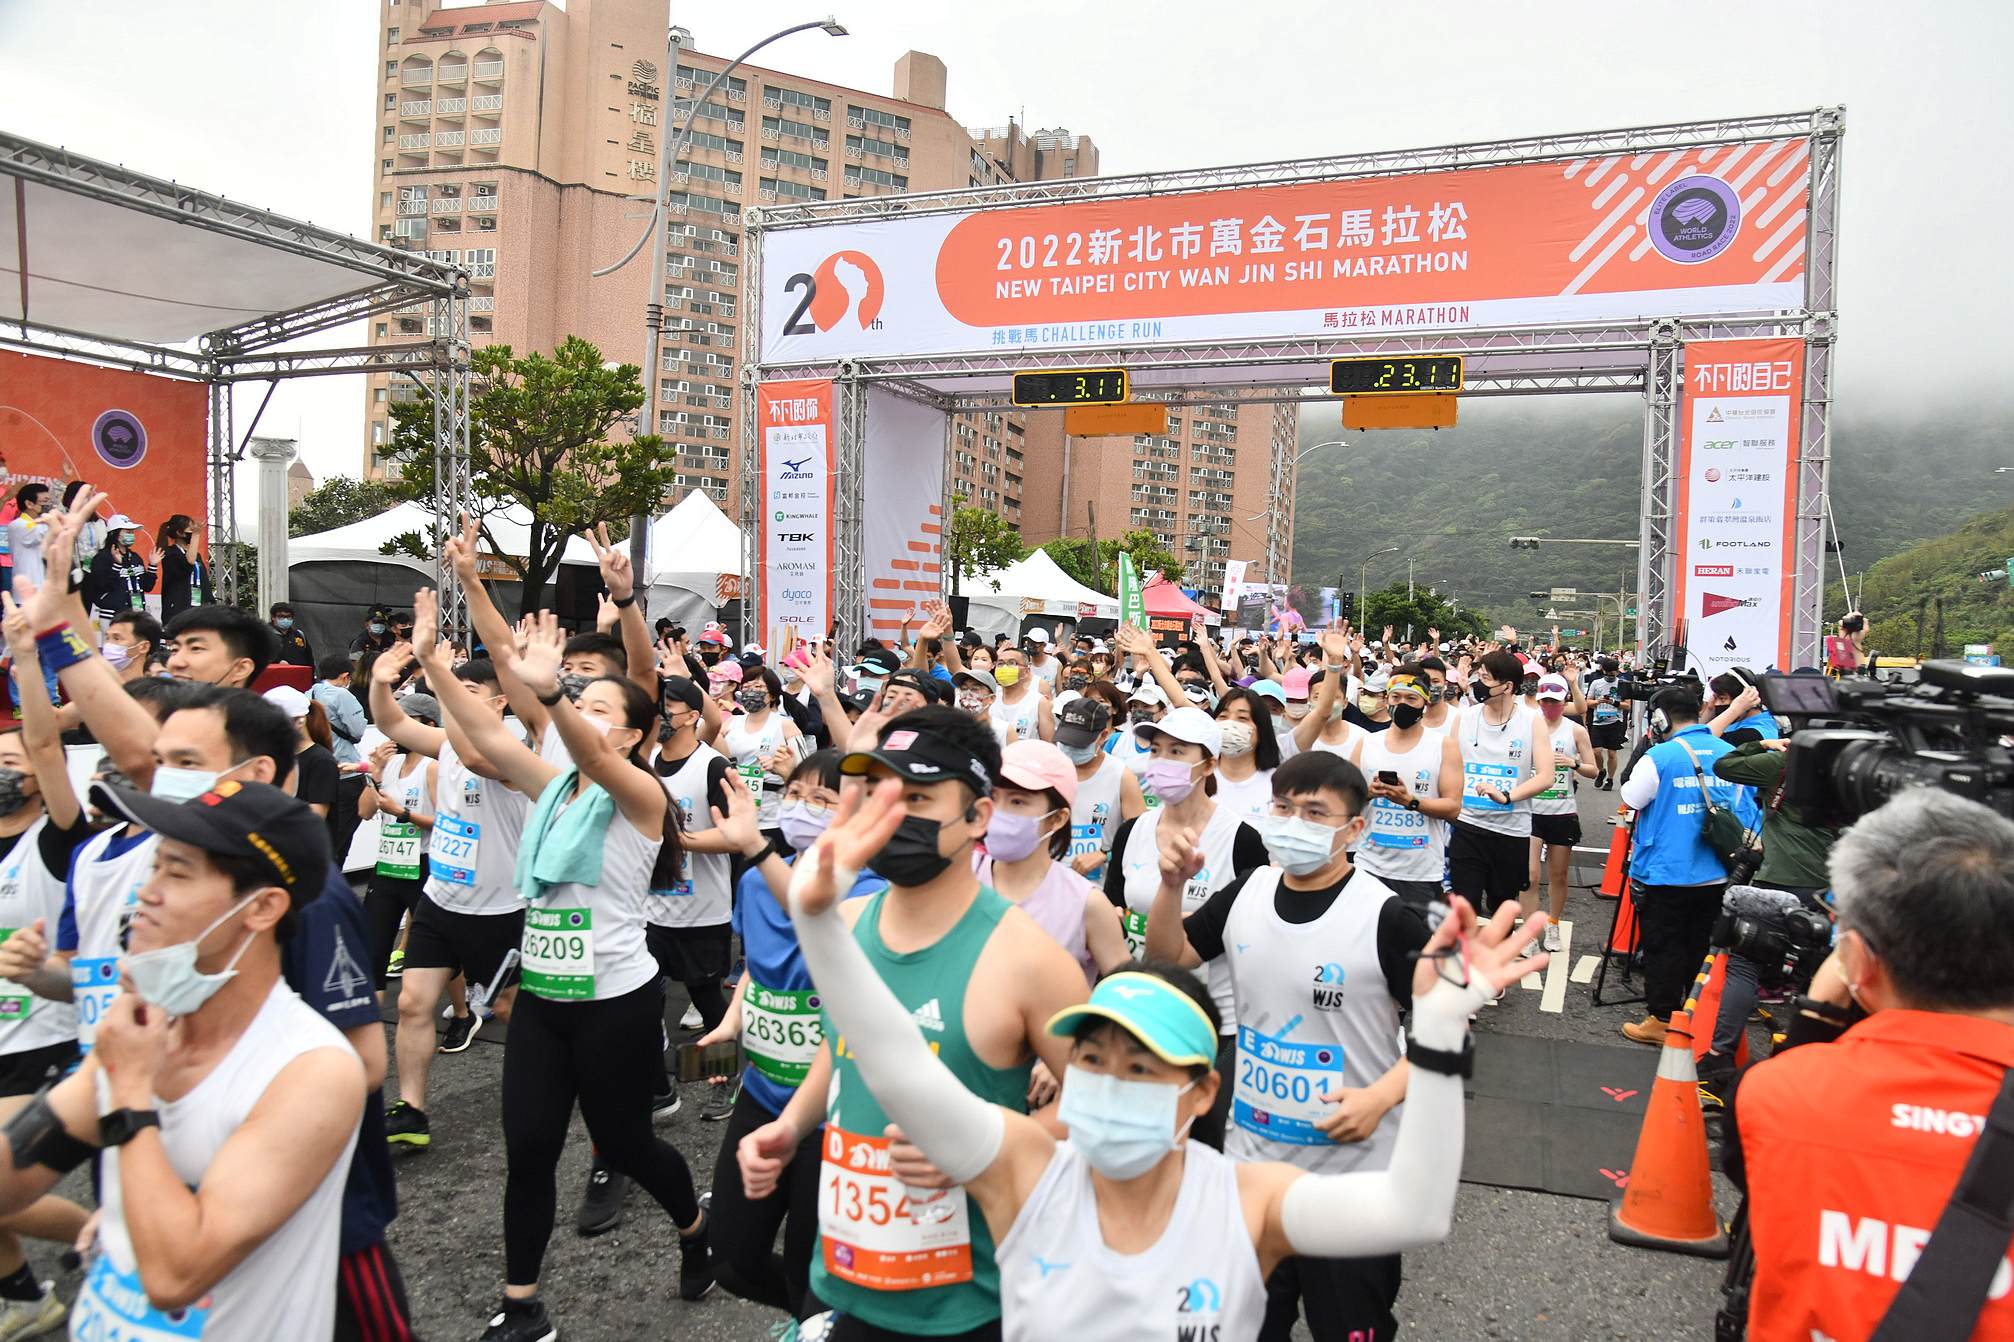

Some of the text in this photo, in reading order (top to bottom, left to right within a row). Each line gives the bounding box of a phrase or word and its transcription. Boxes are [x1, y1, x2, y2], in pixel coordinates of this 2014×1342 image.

[627, 101, 658, 184] 摘星樓
[1665, 183, 1688, 198] LABEL
[1673, 233, 1713, 242] ATHLETICS
[1680, 227, 1707, 235] WORLD
[1691, 248, 1712, 258] ROAD
[1712, 234, 1729, 250] RACE
[996, 251, 1469, 299] NEW TAIPEI CITY WAN JIN SHI MARATHON
[1323, 306, 1470, 328] 馬拉松 MARATHON
[992, 321, 1162, 345] 挑戰馬 CHALLENGE RUN
[1694, 361, 1792, 392] 不凡的自己
[769, 398, 818, 422] 不凡的你
[1703, 440, 1739, 450] acer
[1743, 439, 1776, 447] 智聯服務
[1728, 474, 1771, 482] 太平洋建設
[777, 533, 815, 542] TBK
[1697, 567, 1731, 575] HERAN
[1736, 567, 1770, 575] 禾聯家電
[1468, 764, 1477, 773] E
[1414, 781, 1430, 792] WJS
[1375, 810, 1425, 828] 22583
[379, 840, 415, 856] 26747
[1187, 885, 1208, 898] WJS
[1129, 914, 1140, 931] E
[523, 931, 584, 960] 26209
[746, 981, 756, 1002] E
[1312, 988, 1344, 1008] WJS
[746, 1010, 826, 1047] 26363
[1244, 1030, 1256, 1051] E
[1241, 1059, 1331, 1105] 20601
